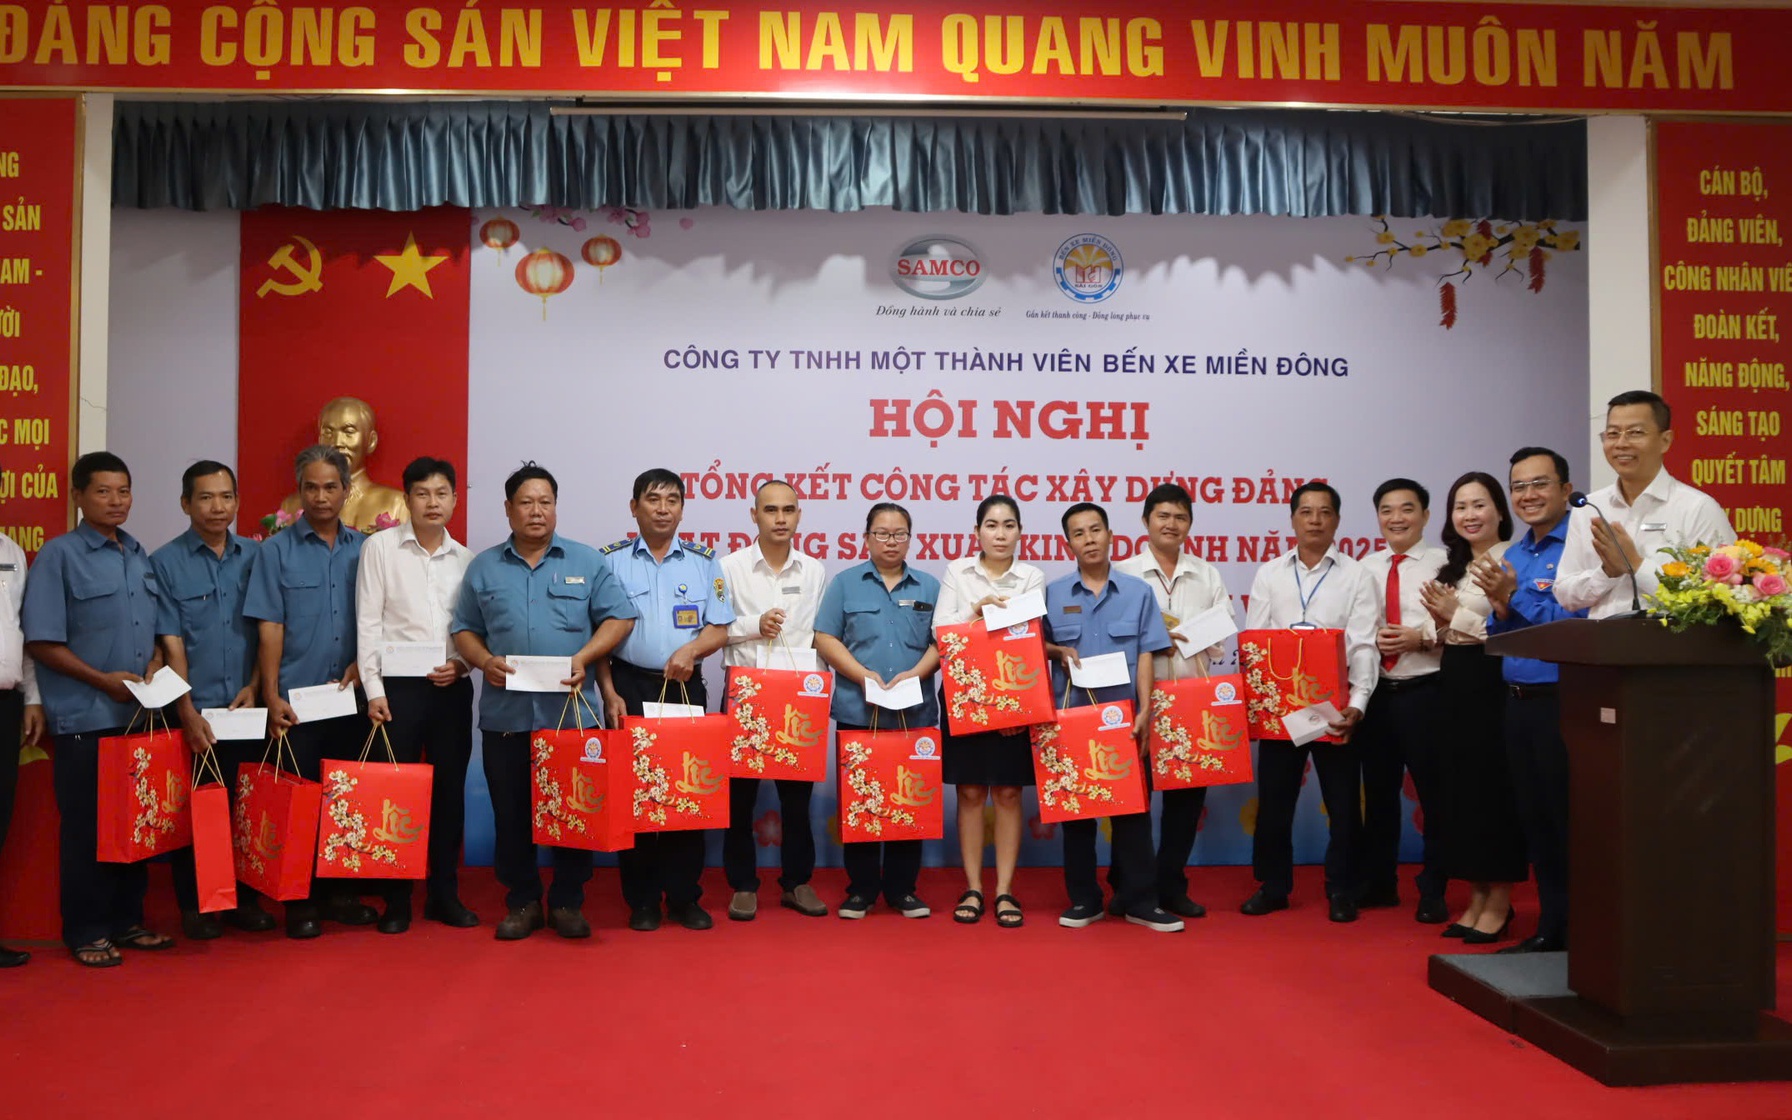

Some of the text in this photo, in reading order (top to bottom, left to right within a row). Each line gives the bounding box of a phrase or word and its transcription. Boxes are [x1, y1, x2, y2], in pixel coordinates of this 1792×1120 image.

[201, 0, 376, 81] CỘNG
[572, 0, 731, 82] VIỆT
[759, 11, 914, 72] NAM
[941, 13, 1165, 82] QUANG
[1191, 19, 1341, 81] VINH
[1366, 17, 1558, 87] MUÔN
[1583, 18, 1733, 90] NĂM
[1700, 165, 1768, 201] CÁN BỘ,
[2, 196, 41, 231] SẢN
[1686, 210, 1783, 247] ĐẢNG VIÊN,
[897, 259, 981, 276] SAMCO
[1664, 261, 1711, 291] CÔNG
[1716, 262, 1764, 292] NHÂN
[960, 307, 986, 316] chia
[1694, 307, 1780, 343] ĐOÀN KẾT,
[664, 345, 1348, 377] CÔNG TY TNHH MỘT THÀNH VIÊN BẾN XE MIỀN ĐÔNG
[1685, 357, 1790, 393] NĂNG ĐỘNG,
[14, 418, 50, 451] MỌI
[869, 389, 1149, 450] HỘI NGHỊ
[1696, 405, 1780, 441] SÁNG TẠO
[21, 463, 58, 499] CỦA
[785, 463, 852, 500] KẾT
[860, 467, 960, 501] CÔNG
[969, 466, 1039, 501] TÁC
[1046, 469, 1118, 502] XÂY
[1232, 469, 1328, 504] ĐẢN
[1691, 451, 1786, 487] QUYẾT TÂM
[0, 526, 44, 552] ANG
[1735, 506, 1782, 538] DỰNG
[1018, 535, 1077, 561] KIN
